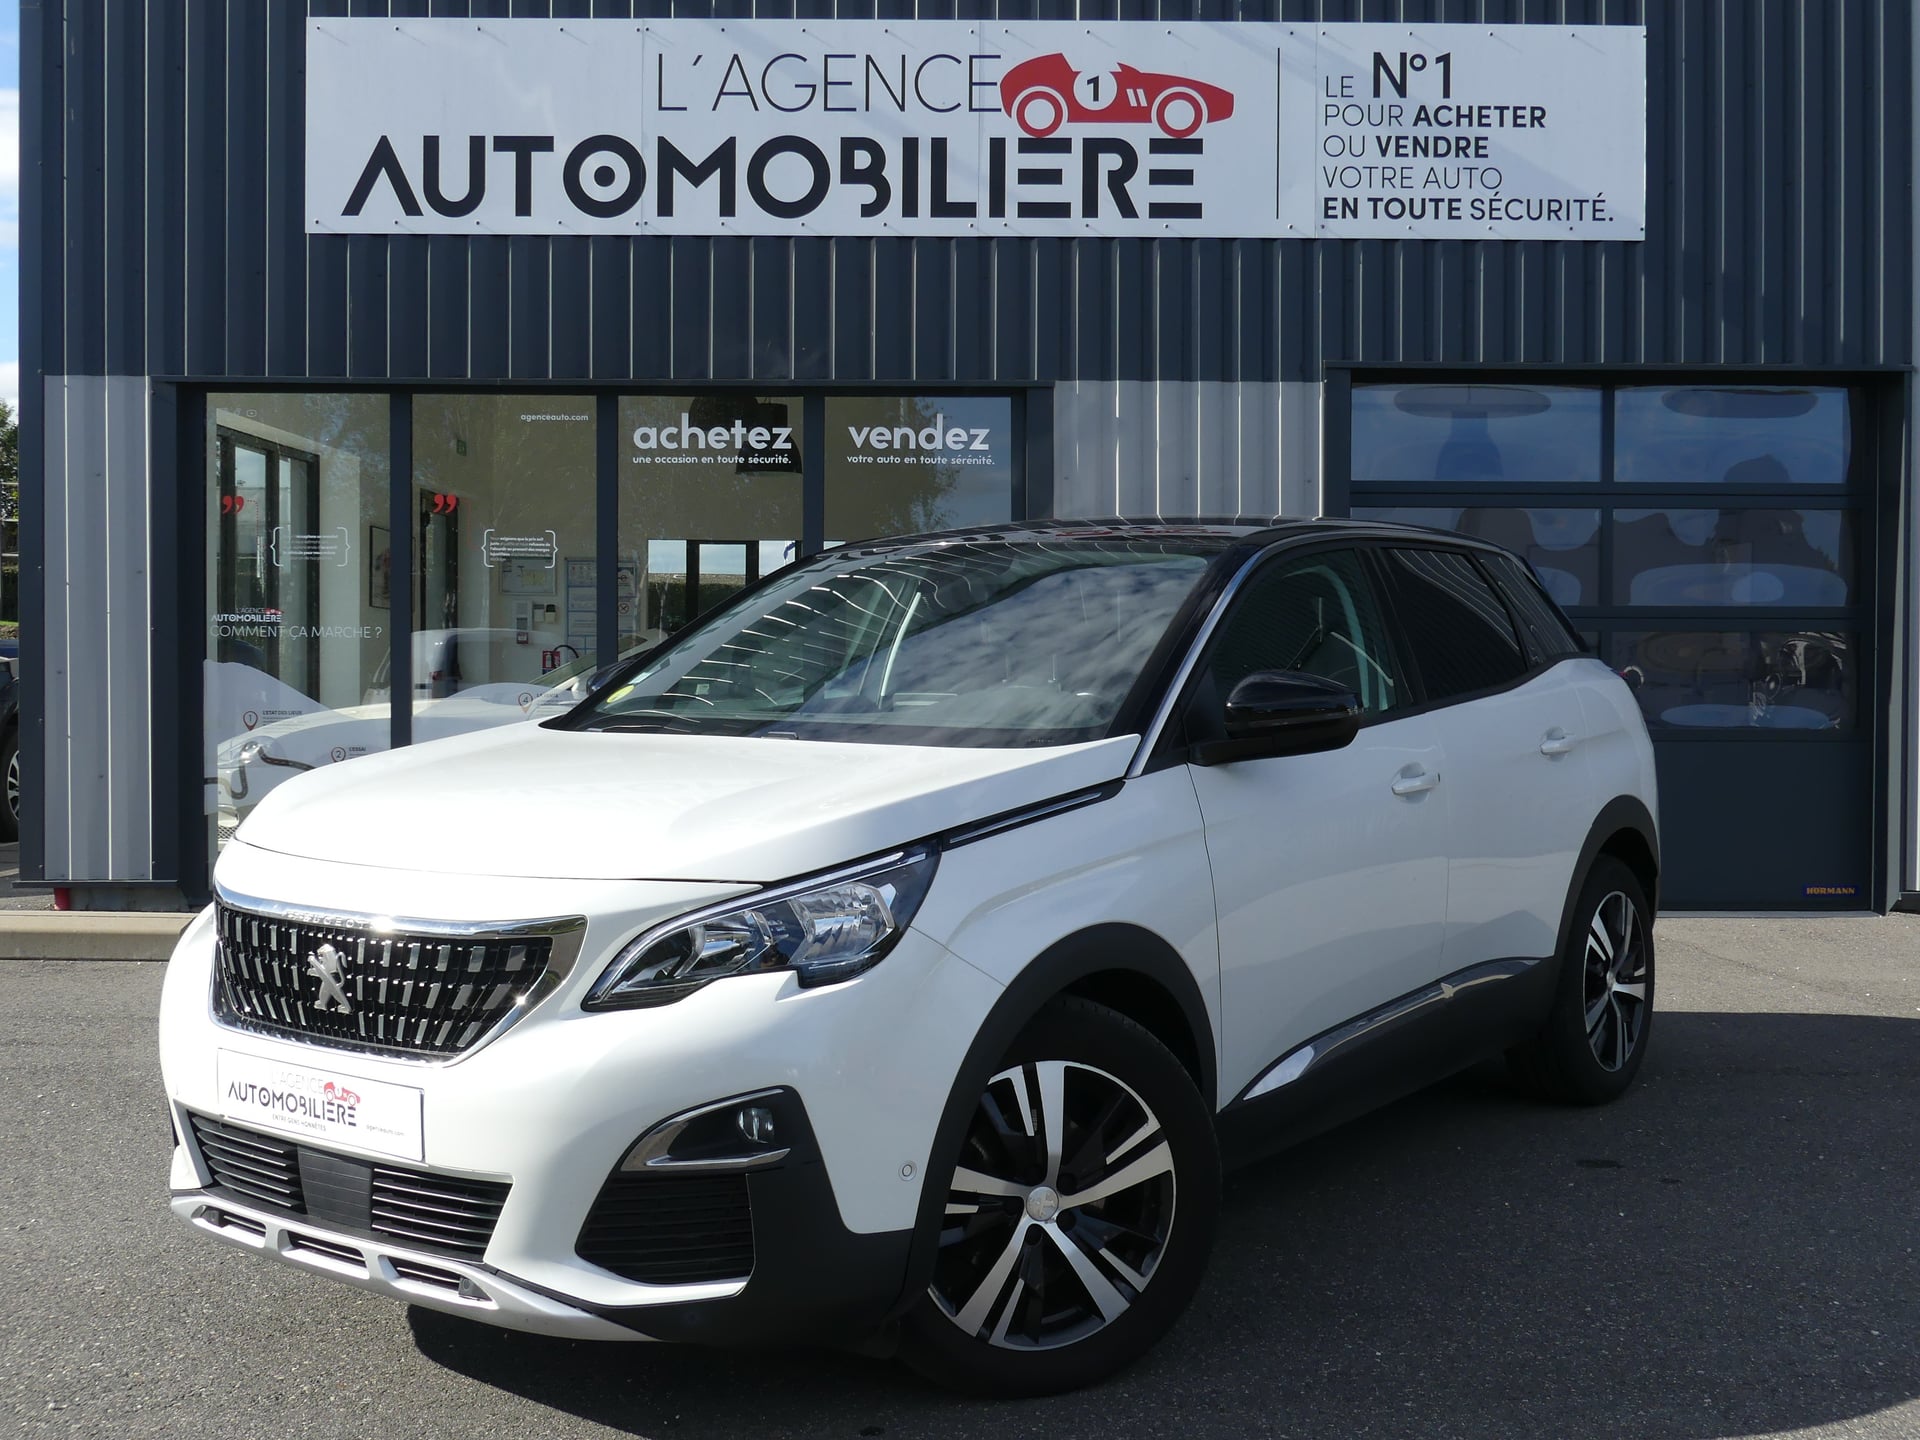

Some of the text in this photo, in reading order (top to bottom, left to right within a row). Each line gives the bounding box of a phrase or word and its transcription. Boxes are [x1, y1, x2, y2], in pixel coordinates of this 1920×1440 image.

[1087, 76, 1099, 102] 1
[1326, 76, 1354, 98] LE
[1325, 104, 1546, 128] POUR ACHETER
[1324, 135, 1489, 158] OU VENDRE
[1323, 167, 1503, 190] VOTRE AUTO
[1324, 192, 1614, 222] EN TOUTE SÉCURITÉ.
[520, 414, 589, 423] agenceauto.com
[633, 412, 793, 450] achetez
[848, 413, 990, 451] vendez
[655, 454, 698, 464] occasion
[718, 455, 745, 464] toute
[748, 453, 792, 464] sécurité.
[847, 455, 874, 464] votre
[877, 455, 901, 464] auto
[920, 456, 948, 465] toute
[951, 454, 995, 465] sérénité.
[209, 625, 382, 641] COMMENT ÇA MARCHE ?
